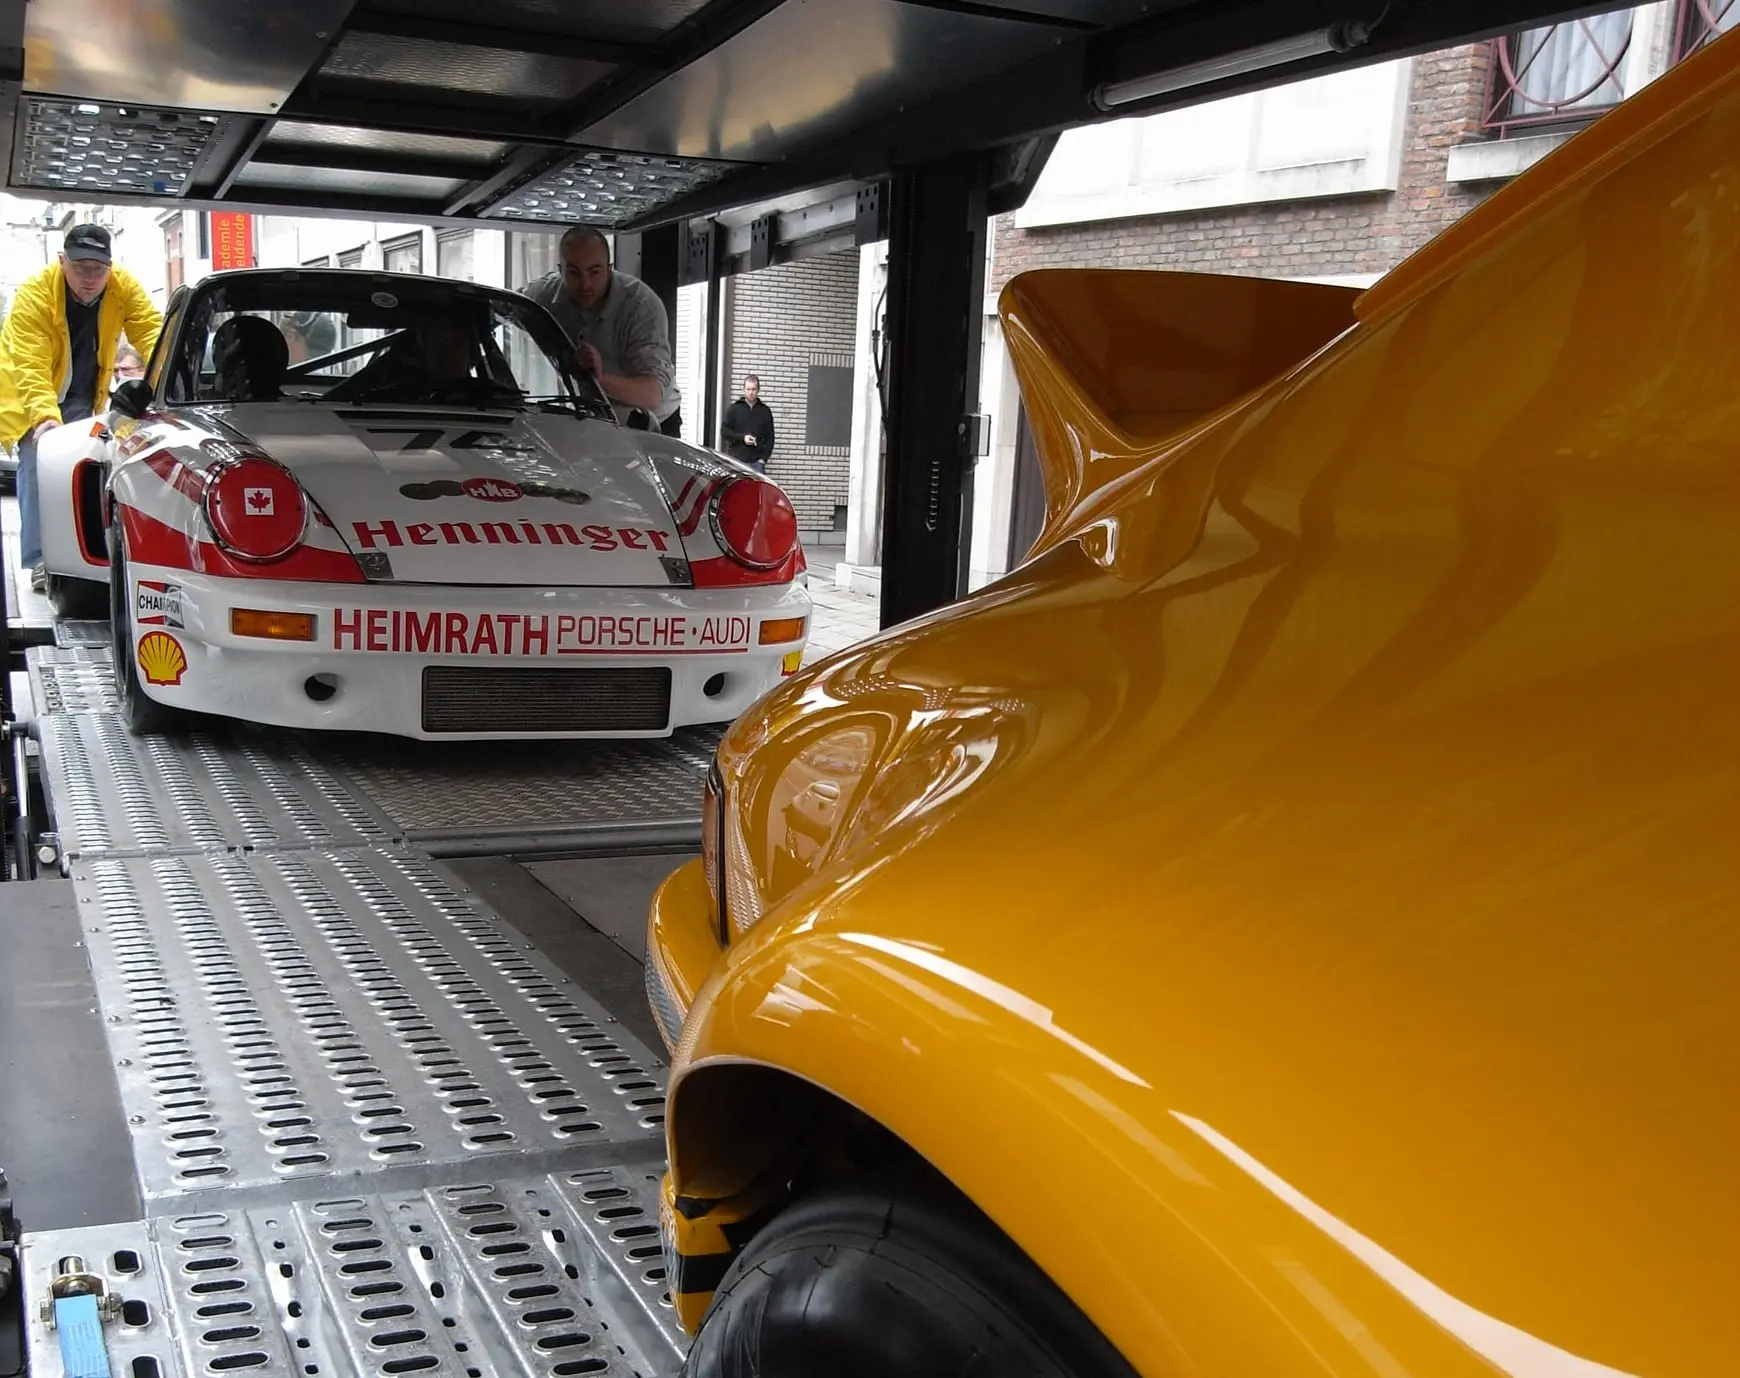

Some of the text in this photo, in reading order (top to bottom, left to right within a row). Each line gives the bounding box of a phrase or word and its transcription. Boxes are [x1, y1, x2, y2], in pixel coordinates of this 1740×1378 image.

[352, 518, 669, 552] Henninger
[333, 608, 751, 656] HEIMRATH PORSCHE AUDI
